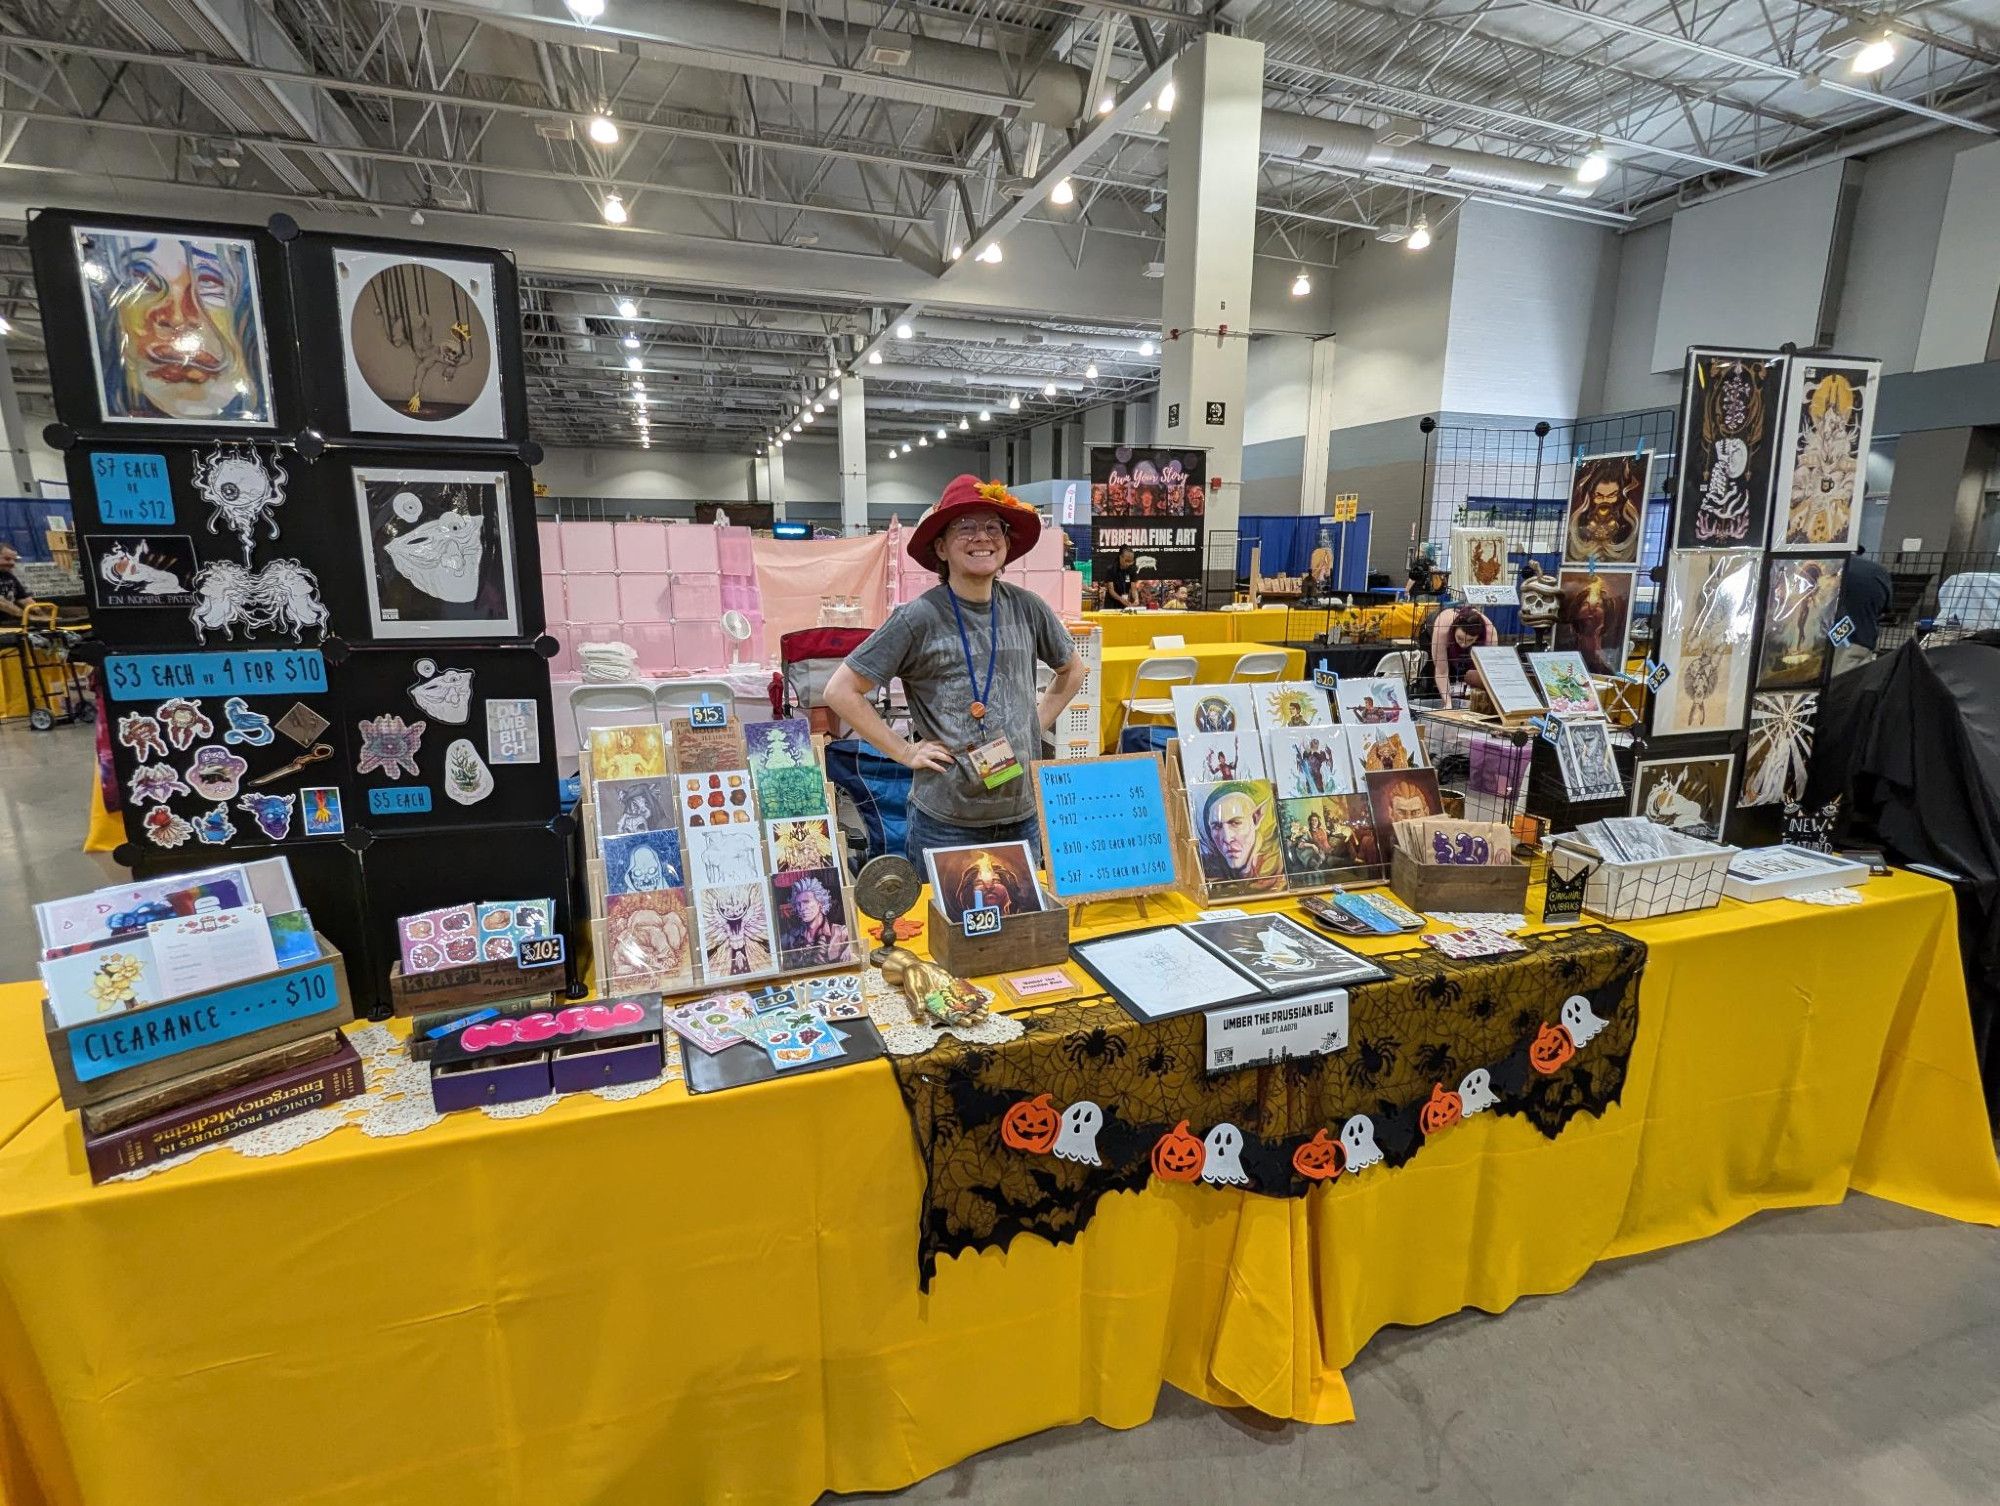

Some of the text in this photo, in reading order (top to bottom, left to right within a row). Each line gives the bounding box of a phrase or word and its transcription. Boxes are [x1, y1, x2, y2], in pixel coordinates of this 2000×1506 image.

[97, 458, 159, 478] $7 EACH
[1160, 466, 1190, 487] Story
[105, 501, 114, 519] 2
[139, 500, 167, 520] $12
[1149, 529, 1173, 545] FINE
[1175, 528, 1197, 545] ART
[108, 595, 124, 605] EN
[114, 662, 141, 689] $3
[152, 663, 195, 689] EACH
[223, 658, 235, 686] 4
[245, 661, 275, 682] FOR
[286, 656, 321, 682] $10
[694, 706, 719, 723] $15
[500, 728, 529, 744] BIT
[501, 742, 526, 756] CH
[1044, 772, 1073, 787] PRINTS
[374, 790, 425, 809] $5 EACH
[1132, 805, 1148, 819] $30
[1788, 817, 1828, 833] NEW
[967, 911, 996, 931] $20
[521, 940, 553, 961] $10
[757, 994, 788, 1009] $10
[85, 974, 327, 1062] CLEARANCE $10
[1223, 1001, 1334, 1030] UMBER THE PRUSSIAN BLUE
[159, 1093, 322, 1156] CLINICAL PROCEDURES IN
